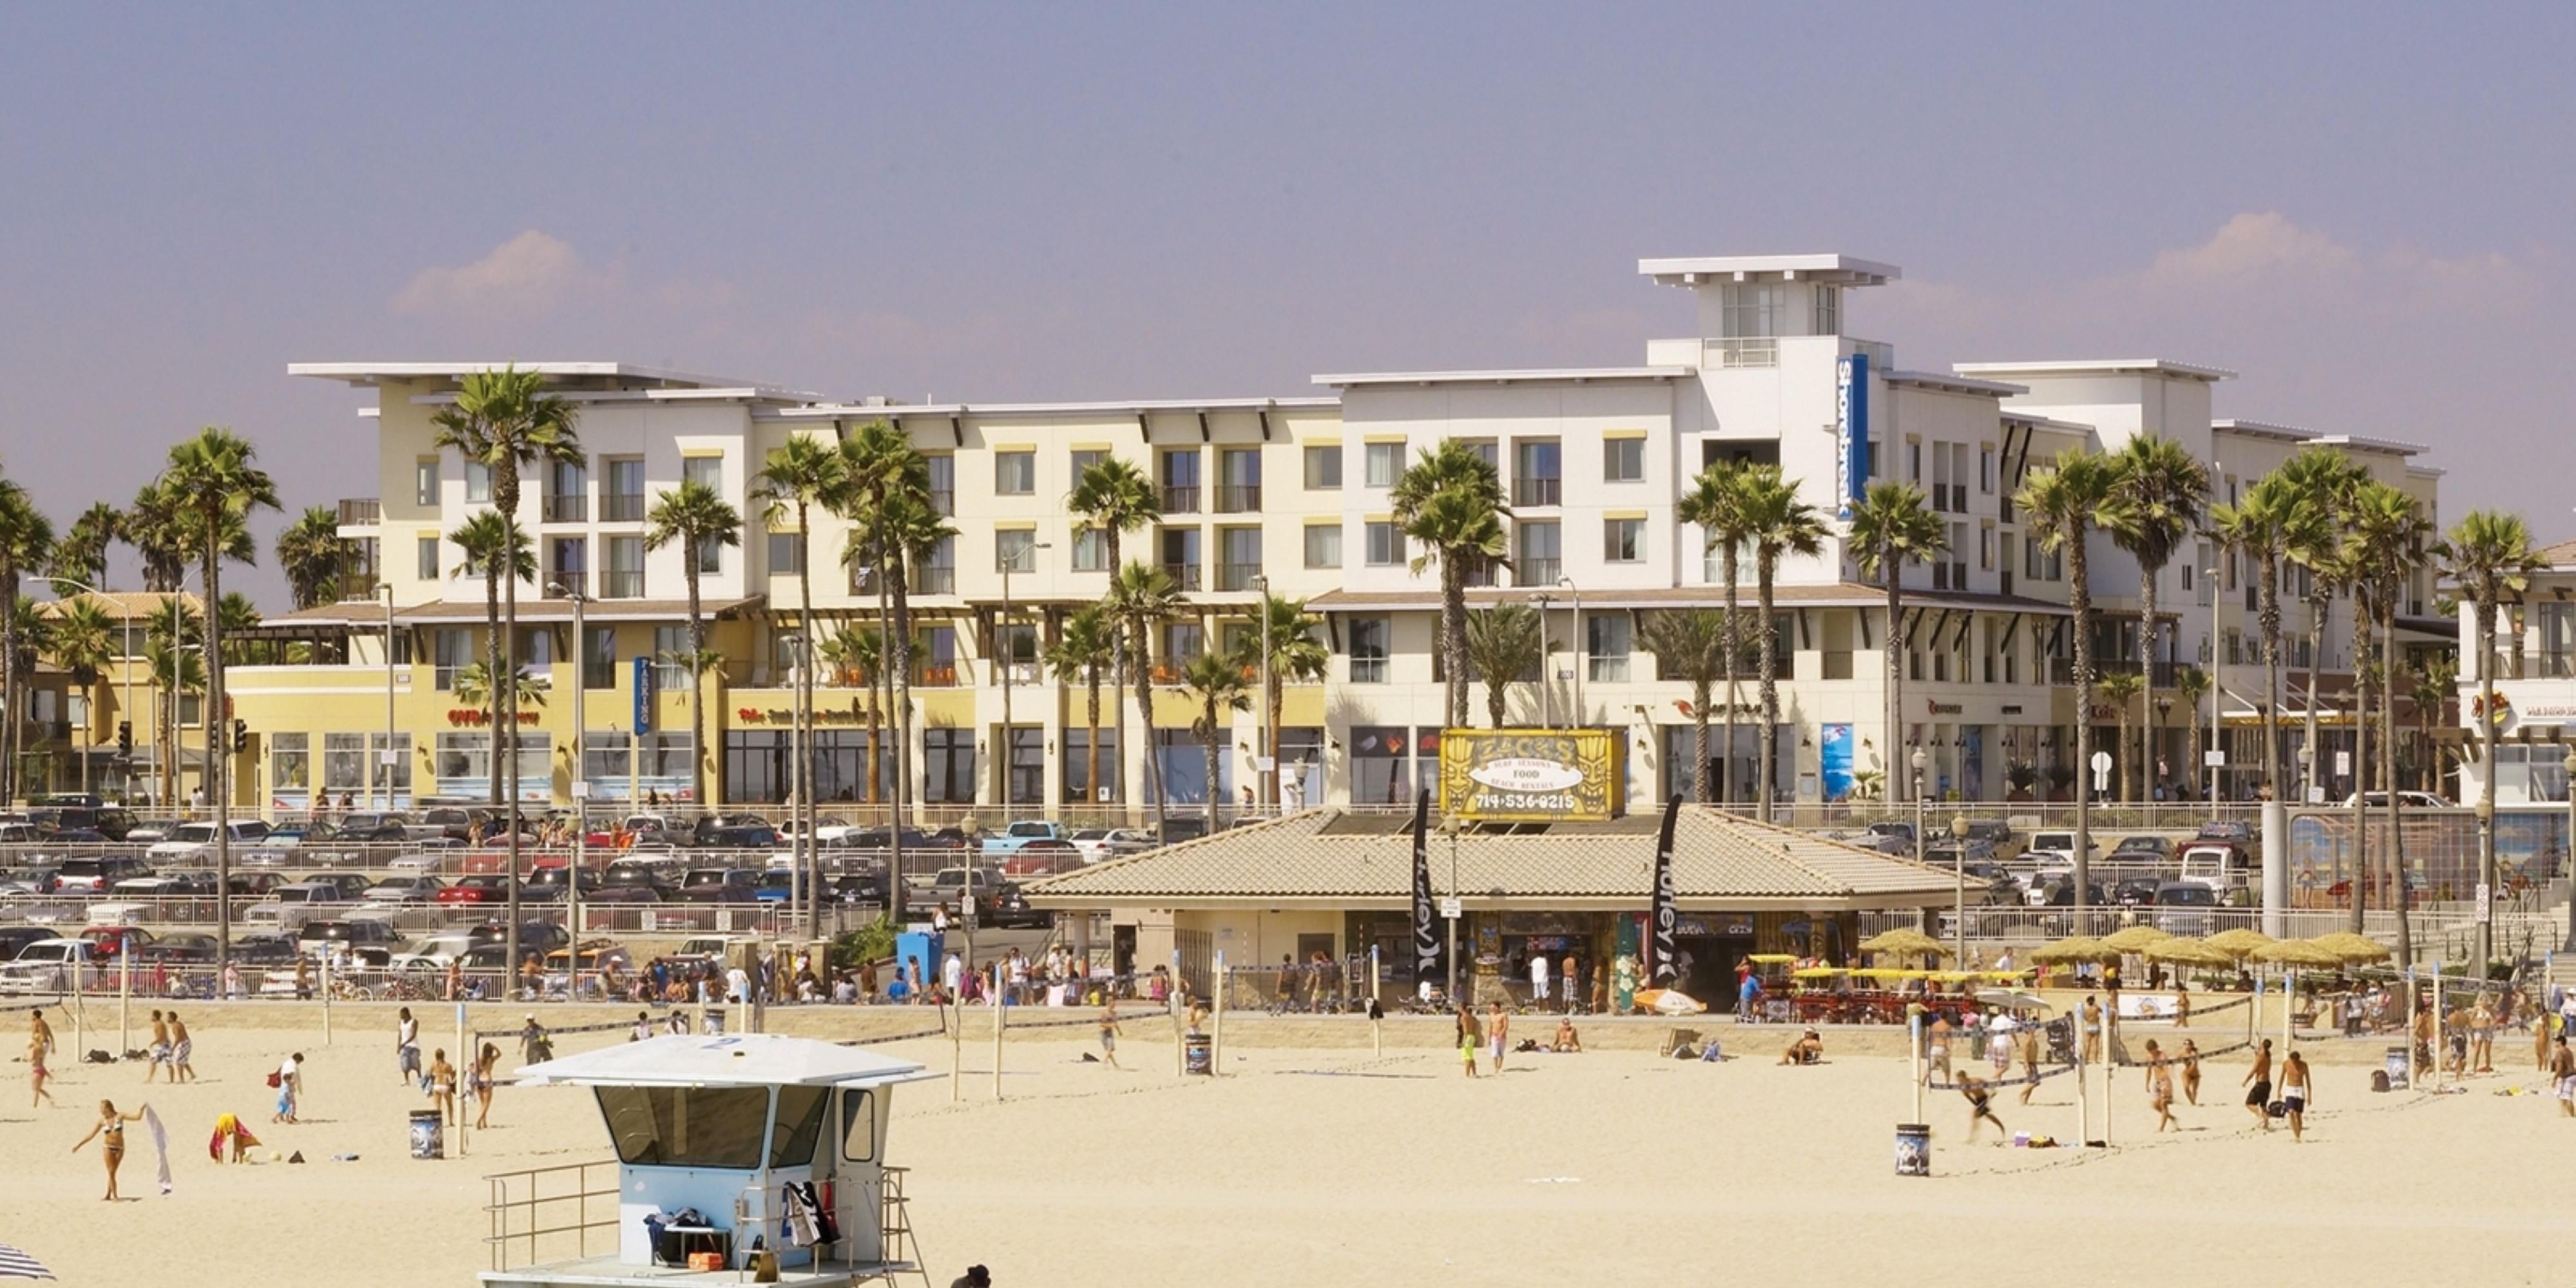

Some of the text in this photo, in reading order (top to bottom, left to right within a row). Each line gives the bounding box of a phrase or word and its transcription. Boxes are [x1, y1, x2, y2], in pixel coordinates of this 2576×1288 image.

[1838, 360, 1852, 515] Shorebreak
[641, 659, 649, 724] PARKING
[1492, 779, 1514, 787] BEACH
[1513, 770, 1540, 779] FOOD
[1417, 848, 1434, 942] Hurley
